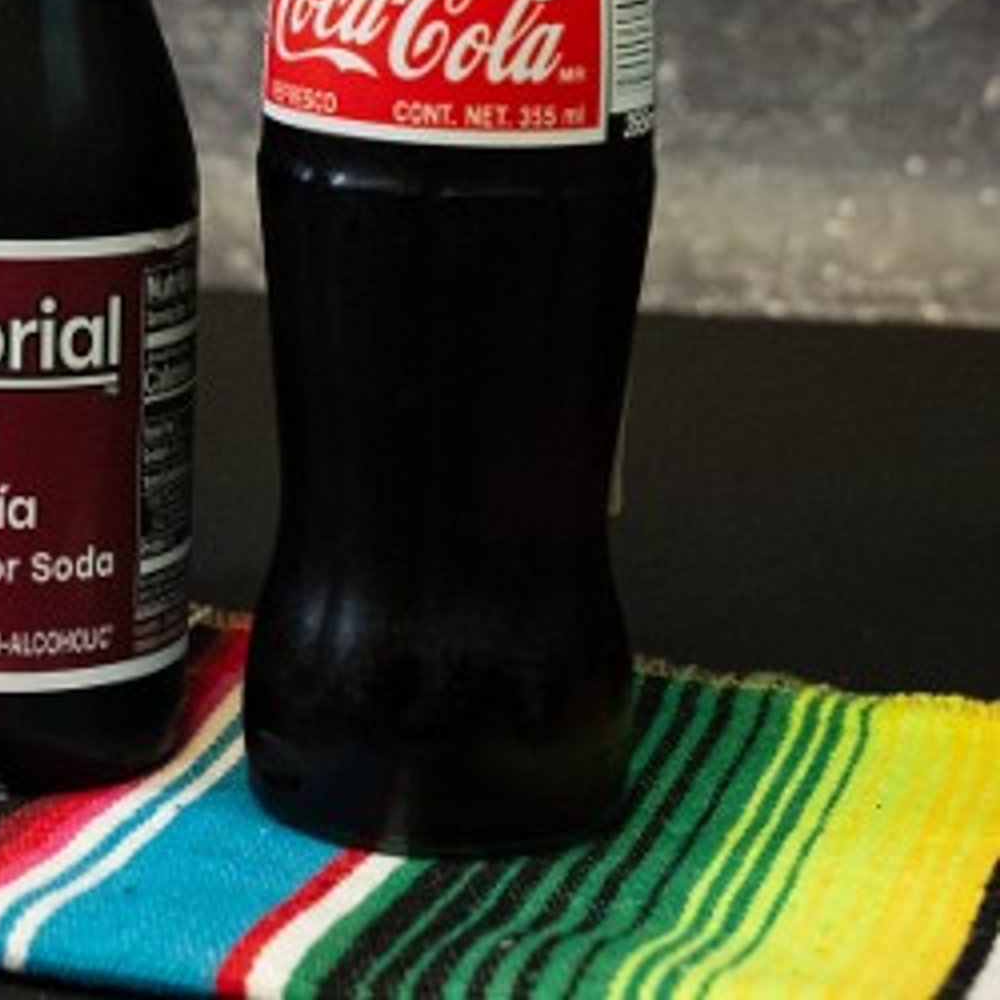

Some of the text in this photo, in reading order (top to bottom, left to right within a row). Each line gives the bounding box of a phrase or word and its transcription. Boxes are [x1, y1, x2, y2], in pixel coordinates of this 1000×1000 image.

[392, 100, 457, 127] CONT.
[464, 103, 513, 129] NET.
[519, 104, 557, 129] 355
[31, 545, 115, 582] Soda
